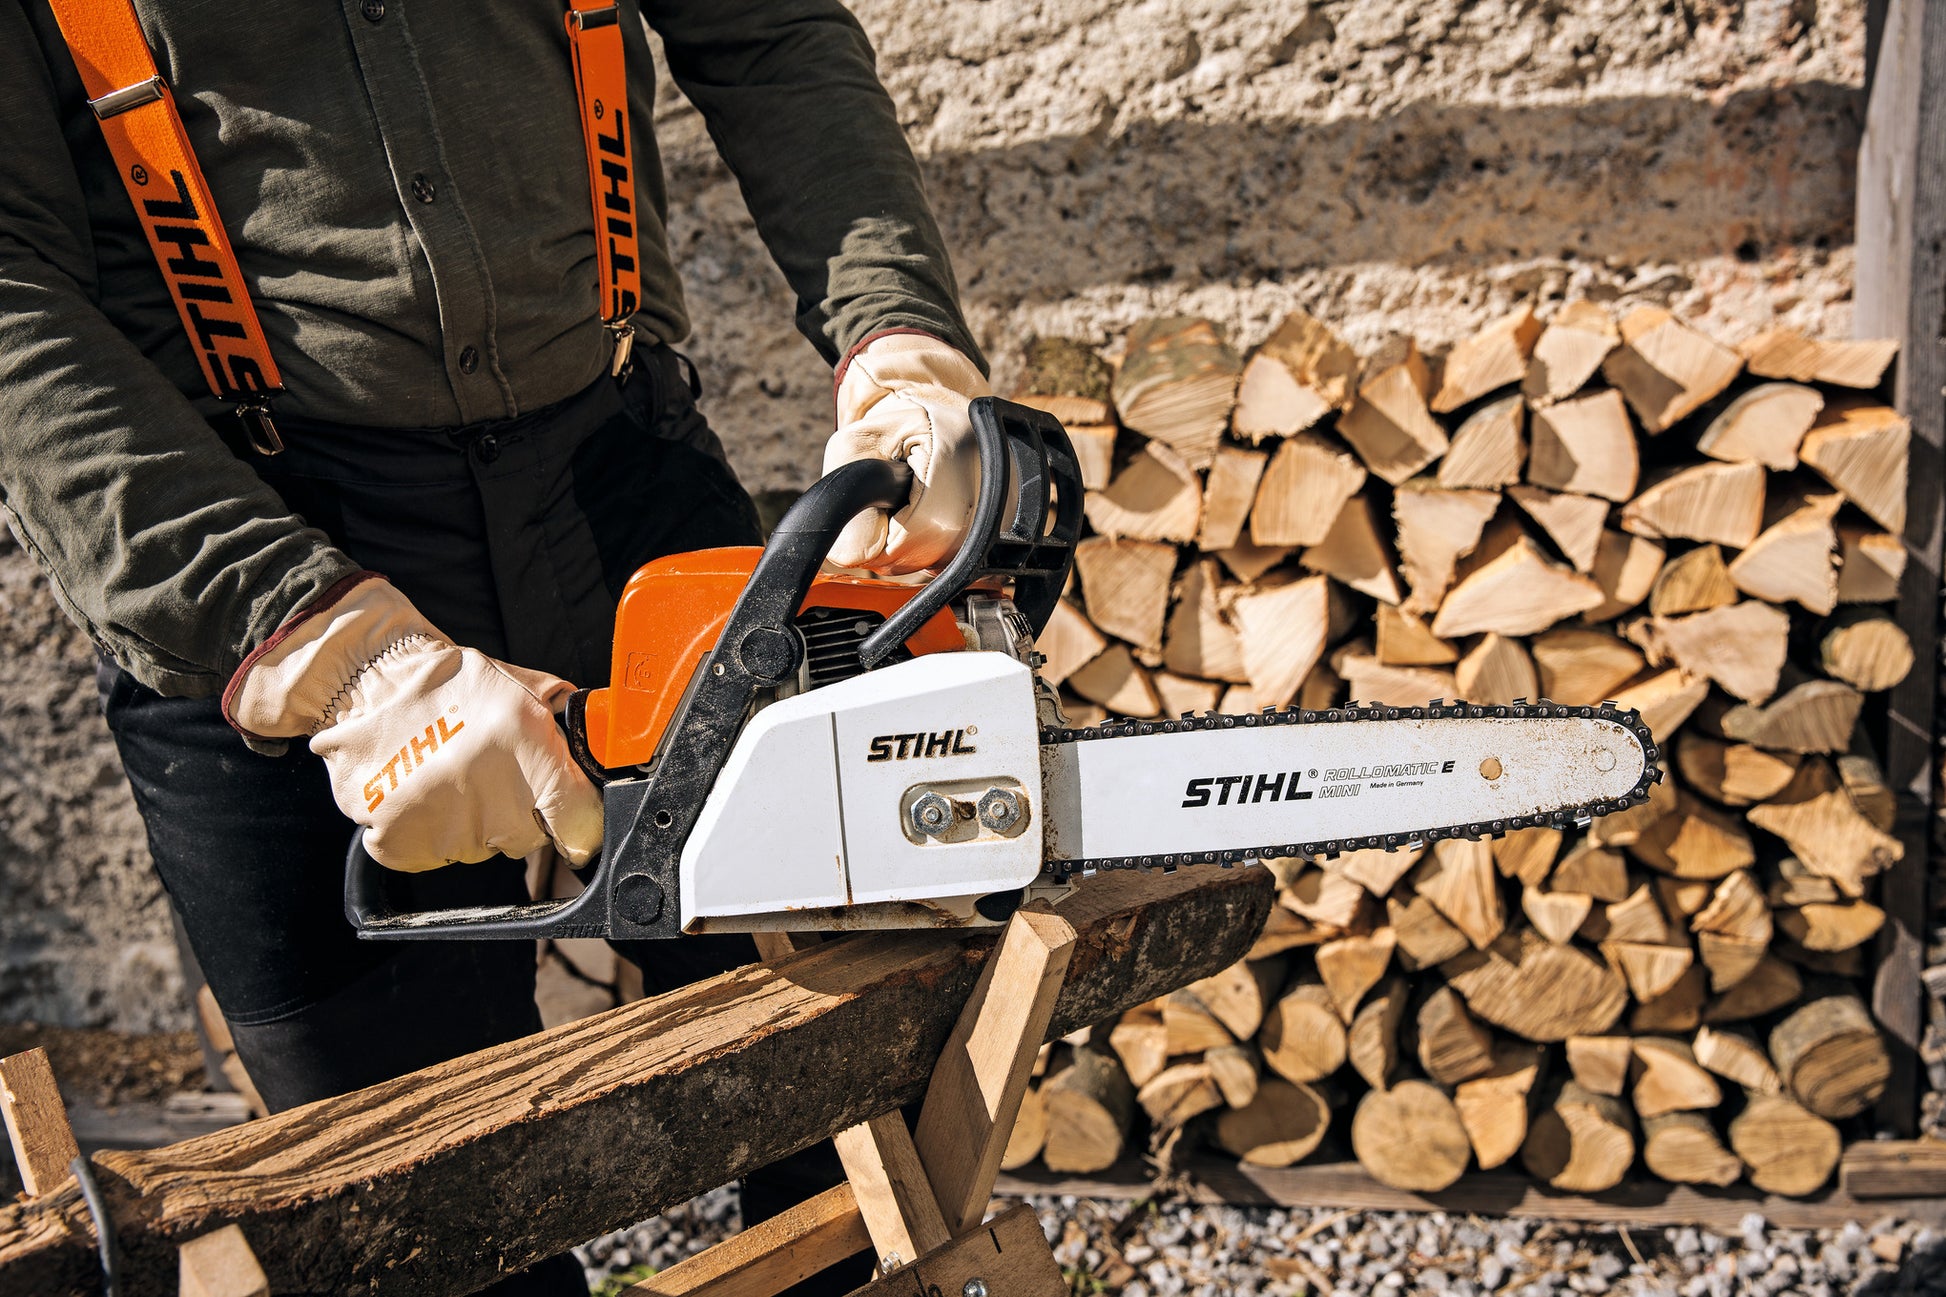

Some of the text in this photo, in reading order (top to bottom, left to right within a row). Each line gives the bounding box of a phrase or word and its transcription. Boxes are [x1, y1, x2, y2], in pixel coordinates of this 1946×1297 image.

[1323, 762, 1439, 781] ROLLOMATIC
[1441, 760, 1456, 774] E
[1319, 784, 1361, 799] MINI
[1369, 781, 1387, 789] Made
[1395, 779, 1424, 788] Germany
